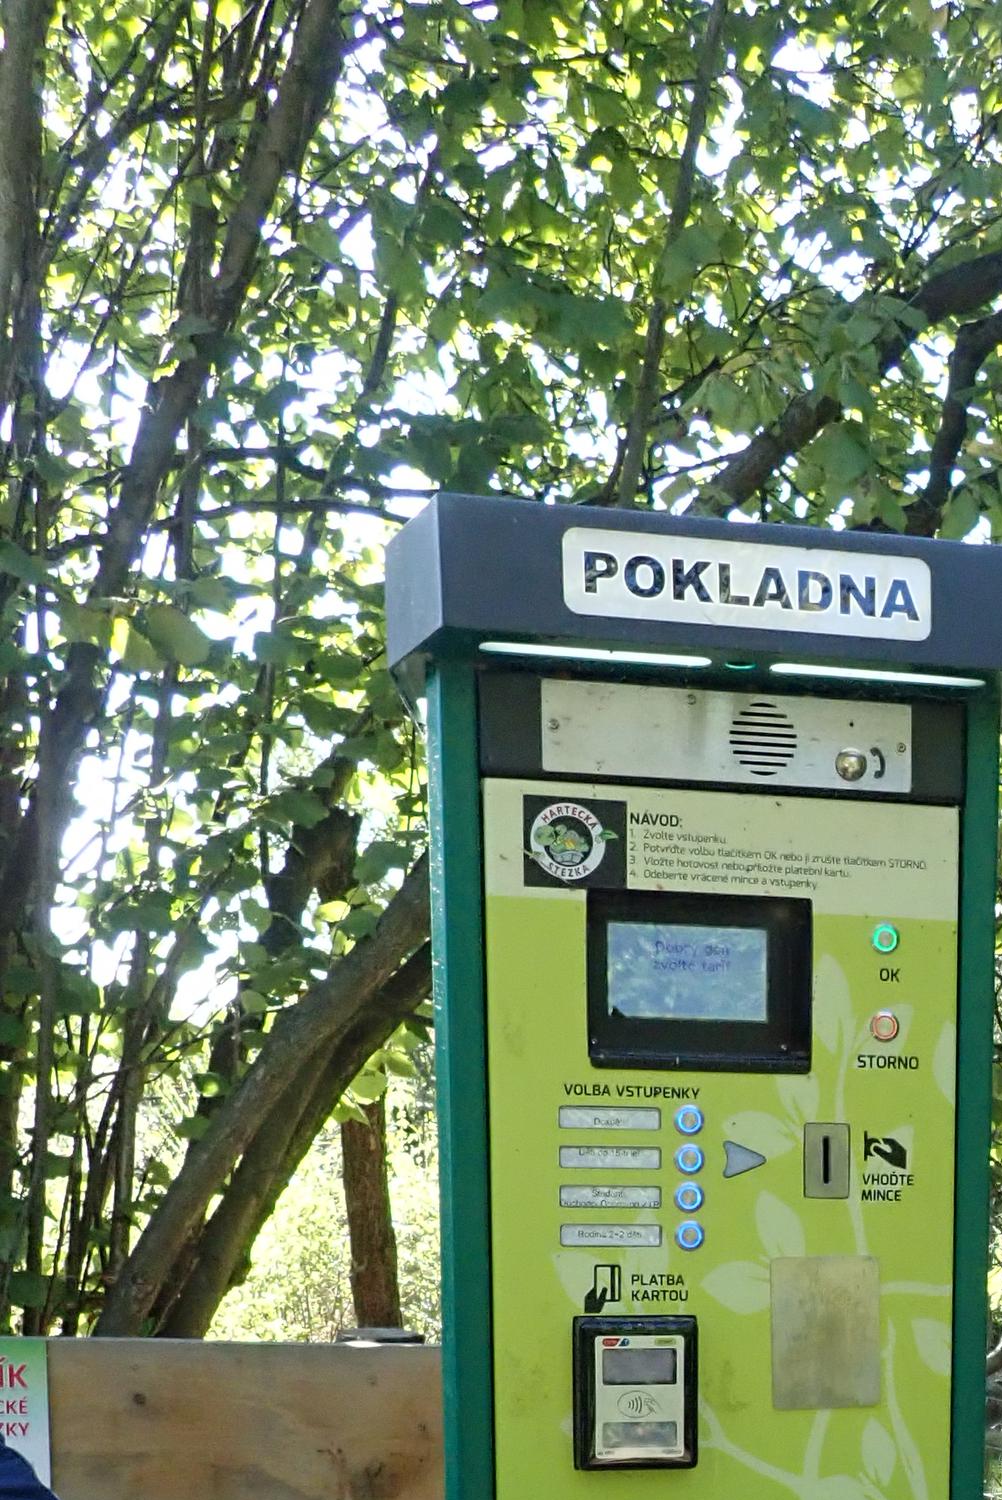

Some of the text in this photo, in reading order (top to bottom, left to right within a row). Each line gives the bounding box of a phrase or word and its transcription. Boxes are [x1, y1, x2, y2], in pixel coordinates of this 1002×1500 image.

[584, 551, 921, 622] POKLADNA
[630, 810, 682, 828] NÁVOD:
[643, 829, 674, 841] Zvolte
[643, 842, 685, 855] Potvrďte
[688, 846, 715, 857] volbu
[718, 848, 762, 860] tlačítkem
[764, 850, 777, 860] OK
[780, 852, 803, 862] nebo
[812, 855, 841, 865] zrušte
[843, 855, 886, 867] tlačítkem
[548, 862, 590, 877] STEZKA
[643, 856, 675, 868] Vložte
[676, 858, 719, 870] hotovost
[721, 861, 744, 871] nebo
[785, 865, 823, 876] platební
[643, 868, 688, 881] Odeberte
[690, 871, 729, 883] vrácené
[730, 875, 759, 885] mince
[761, 878, 767, 886] a
[880, 968, 900, 982] OK
[857, 1055, 919, 1069] STORNO
[564, 1084, 700, 1099] VOLBA VSTUPENKY
[863, 1171, 915, 1186] VHOĎTE
[862, 1189, 902, 1201] MINCE
[631, 1274, 684, 1286] PLATBA
[631, 1289, 688, 1301] KARTOU
